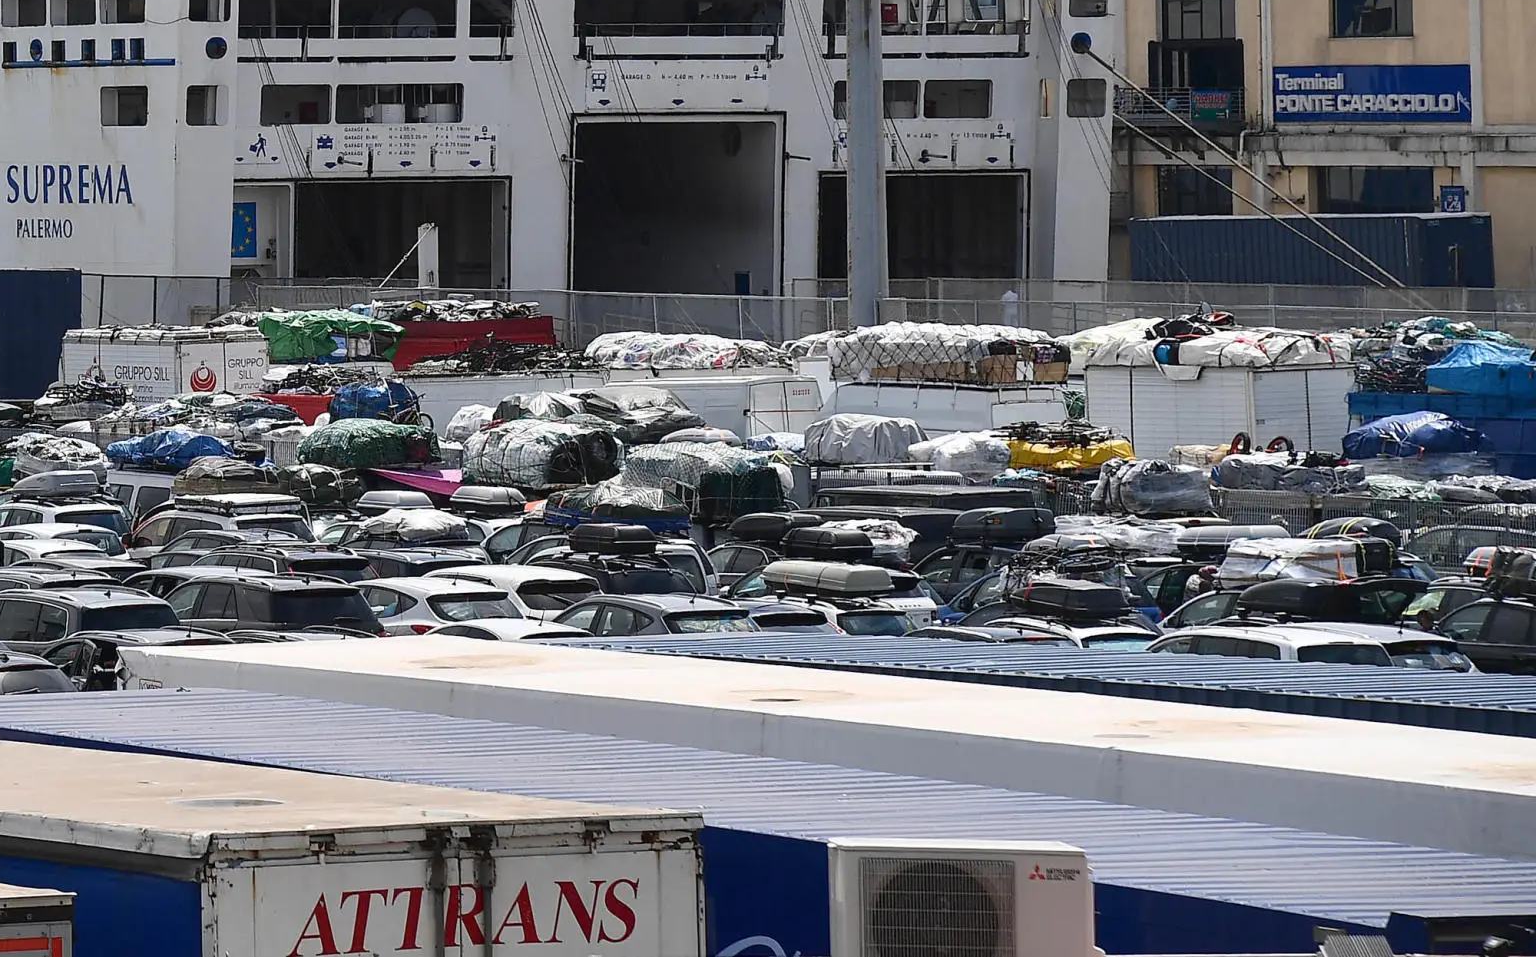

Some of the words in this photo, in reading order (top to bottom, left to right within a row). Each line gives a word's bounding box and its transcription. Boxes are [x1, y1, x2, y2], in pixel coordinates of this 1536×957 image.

[1275, 72, 1344, 91] Terminal
[1275, 94, 1335, 113] PONTE
[1336, 94, 1456, 113] CARACCIOLO
[7, 164, 134, 204] SUPREMA
[16, 218, 73, 239] PALERMO
[227, 357, 264, 369] GRUPPO
[113, 365, 152, 382] GRUPPO
[153, 366, 170, 382] SILL
[238, 370, 254, 380] SILL
[286, 877, 640, 957] ATTRANS
